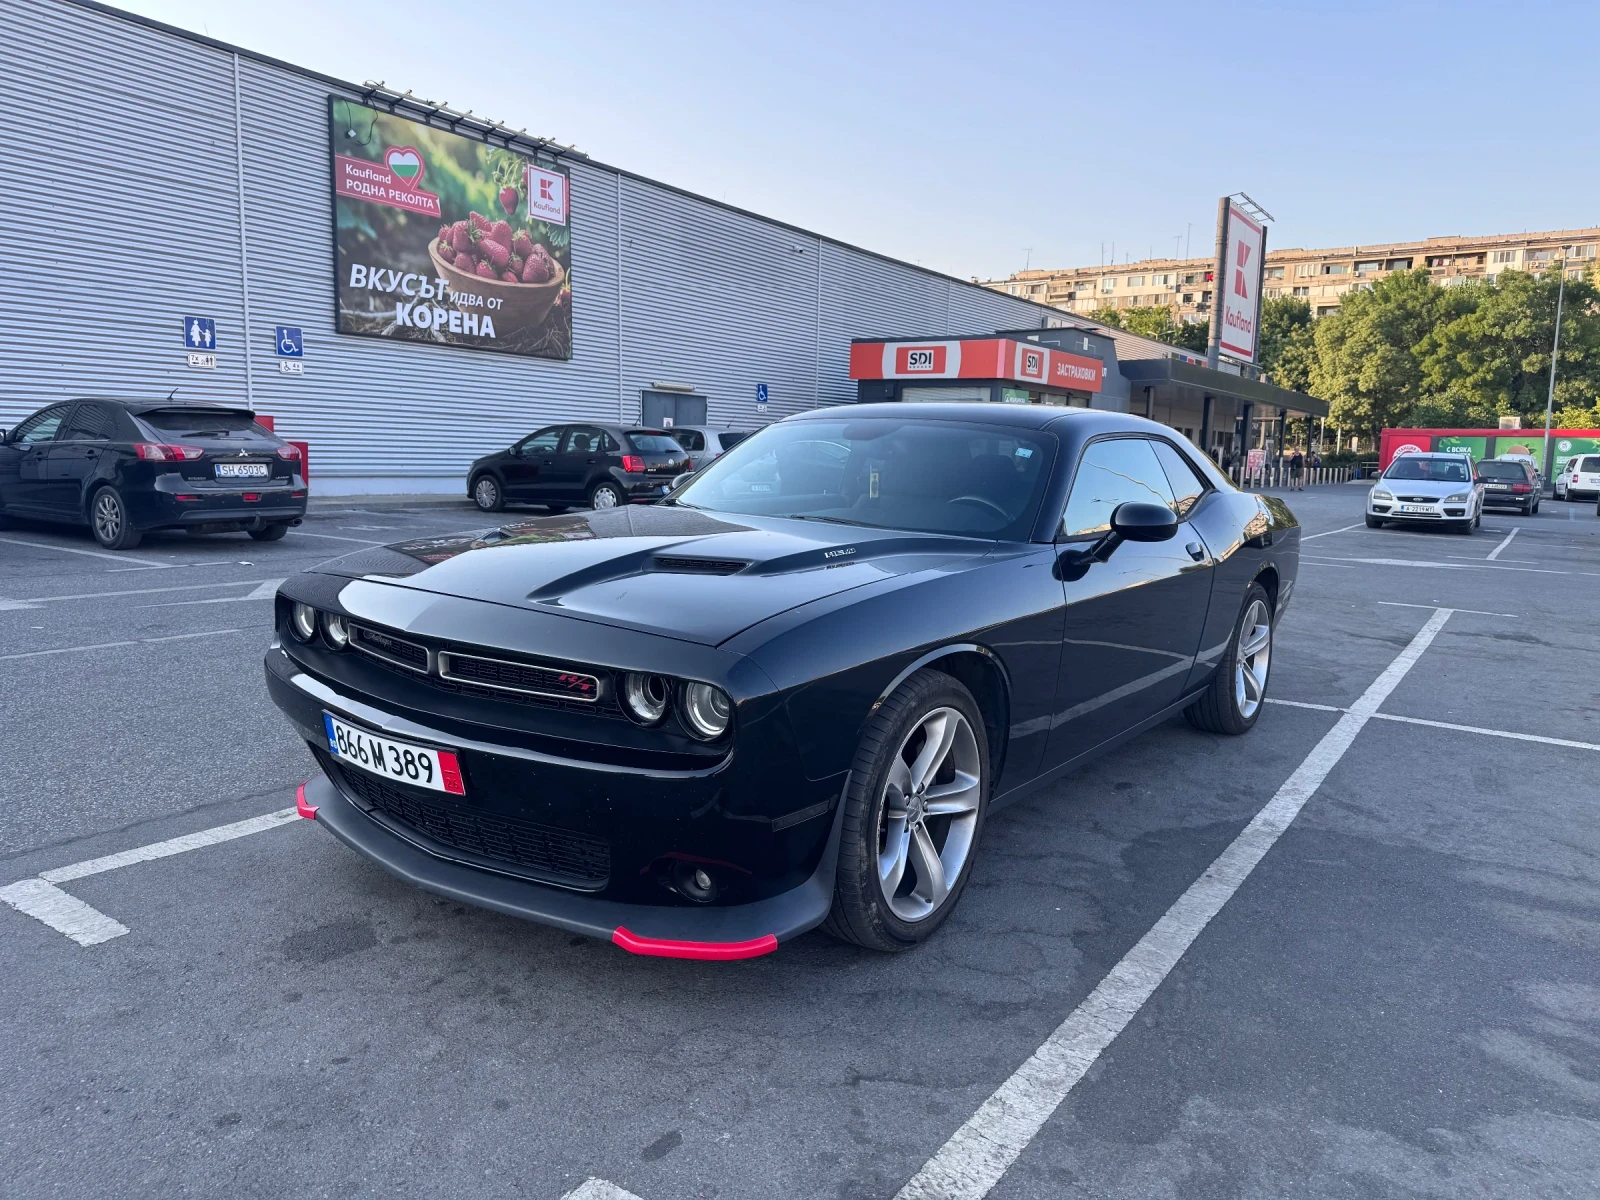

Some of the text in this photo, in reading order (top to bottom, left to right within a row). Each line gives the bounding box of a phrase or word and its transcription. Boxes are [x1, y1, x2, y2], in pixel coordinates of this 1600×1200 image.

[346, 164, 391, 184] Kaufland
[346, 179, 434, 209] РОДНА РЕКОЛТА
[533, 200, 561, 214] Kaufland
[350, 263, 504, 310] ВКУСЪТ ИДВА ОТ
[396, 302, 496, 338] КОРЕНА
[1225, 305, 1252, 334] Kaufland
[909, 352, 932, 365] SDI
[1027, 355, 1038, 369] SDI
[1056, 363, 1096, 381] ЗАСТРАХОВКИ
[222, 465, 235, 475] SH
